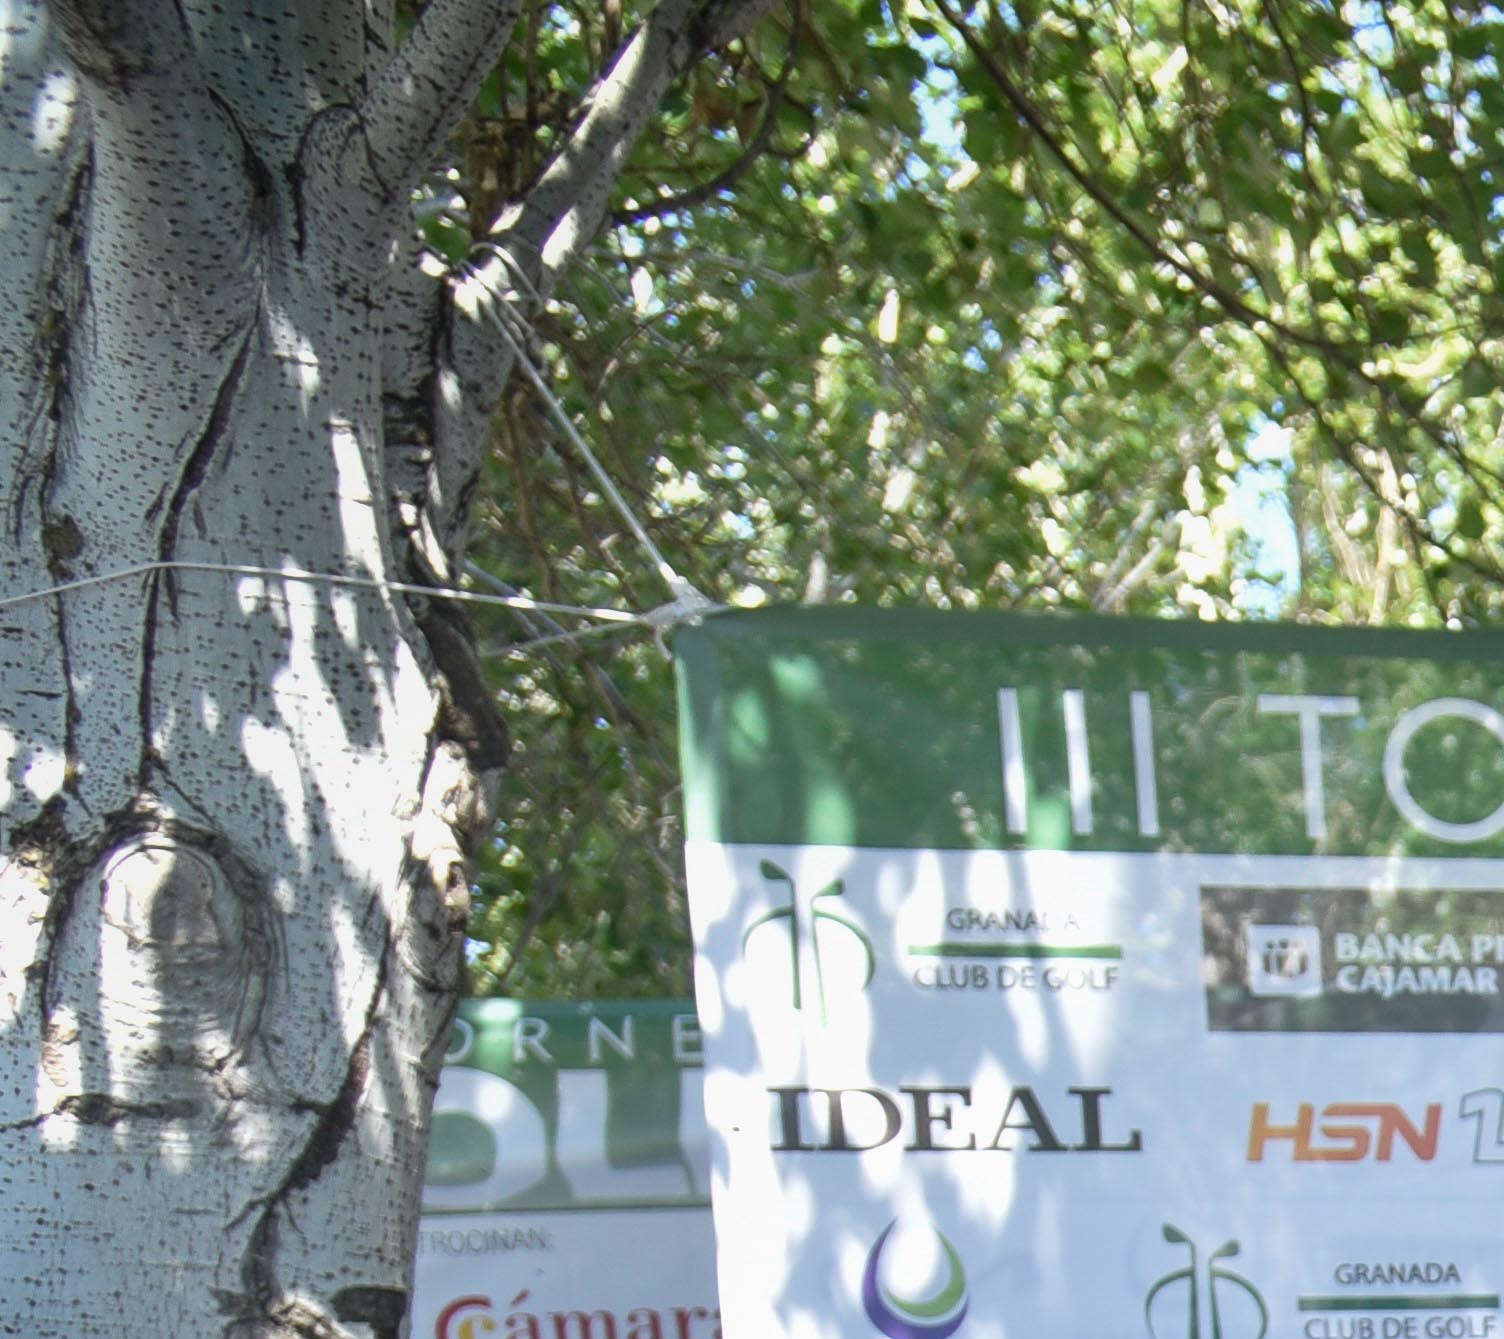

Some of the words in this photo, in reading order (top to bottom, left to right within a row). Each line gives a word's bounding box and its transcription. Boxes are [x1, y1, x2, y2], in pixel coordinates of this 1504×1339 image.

[998, 689, 1160, 838] III
[1335, 932, 1462, 965] BANCA
[913, 964, 990, 990] CLUB
[997, 966, 1038, 990] DE
[1042, 966, 1120, 991] GOLF
[1335, 966, 1499, 999] CAJAMAR
[766, 1086, 1142, 1153] IDEAL
[1245, 1102, 1441, 1163] HSN
[1334, 1260, 1461, 1287] GRANADA
